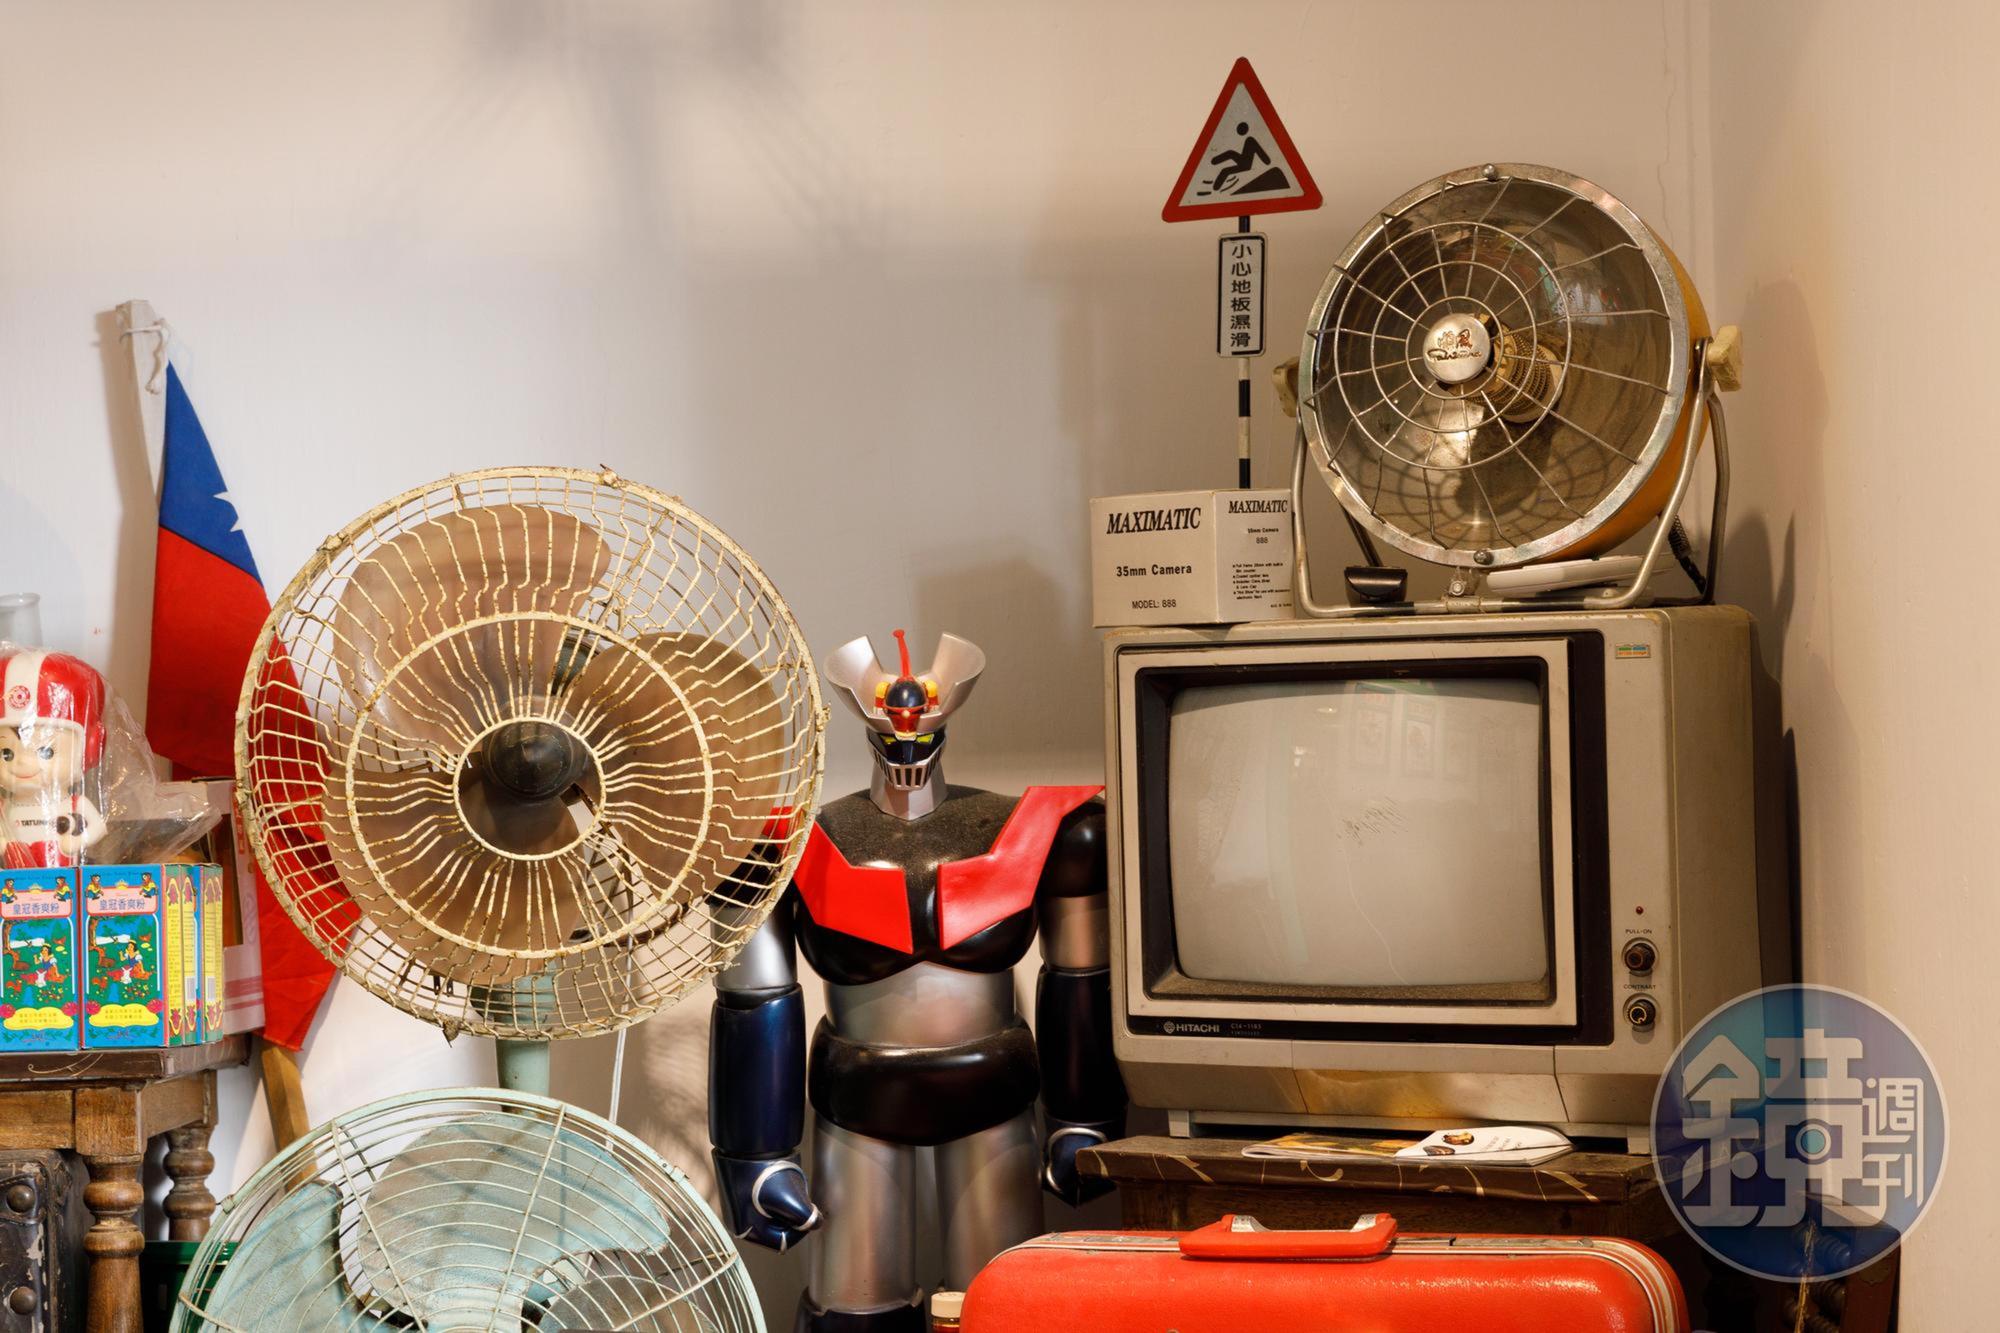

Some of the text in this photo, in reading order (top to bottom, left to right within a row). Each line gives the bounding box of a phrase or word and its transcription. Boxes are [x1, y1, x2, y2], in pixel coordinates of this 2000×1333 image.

[1230, 243, 1252, 348] 小心地板濕滑
[1228, 499, 1289, 514] MAXIMATIC
[1106, 506, 1202, 535] MAXIMATIC
[1116, 564, 1193, 577] 35mm Camera
[1131, 599, 1177, 609] MODEL: 888
[13, 902, 60, 915] 皇冠香爽粉
[100, 898, 146, 911] 皇冠香爽粉
[1176, 1023, 1220, 1033] HITACHI
